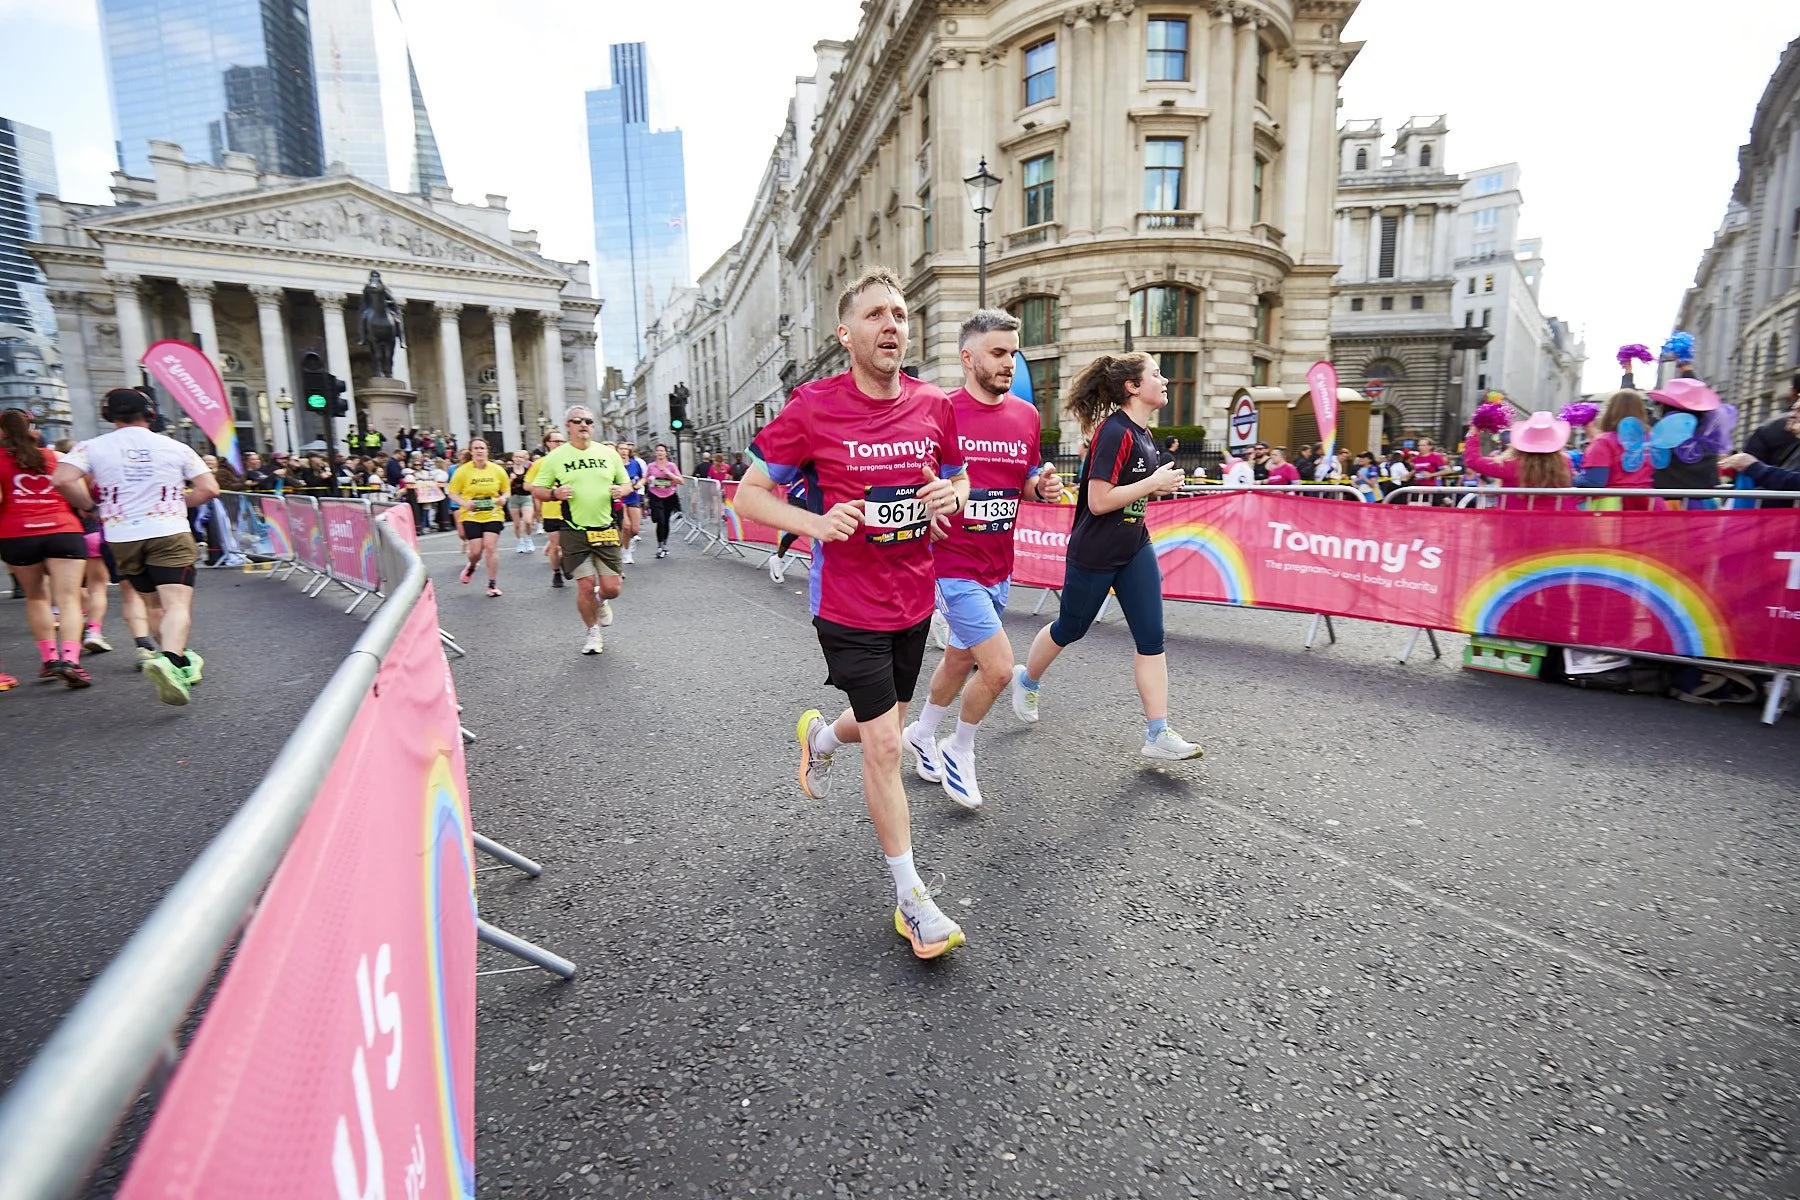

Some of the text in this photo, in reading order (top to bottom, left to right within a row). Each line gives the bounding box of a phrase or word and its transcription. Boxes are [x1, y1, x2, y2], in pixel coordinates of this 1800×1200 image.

[842, 436, 935, 459] Tommy's
[957, 435, 1028, 457] Tommy's
[563, 458, 608, 473] MARK
[860, 463, 892, 472] pregnancy
[893, 461, 905, 470] and
[906, 461, 921, 470] baby
[895, 488, 915, 496] ADAM
[878, 502, 927, 524] 9612
[970, 501, 1016, 517] 11333
[1132, 500, 1145, 513] 65
[1267, 521, 1444, 573] Tommy's
[1264, 559, 1438, 594] The pregnancy and baby charity
